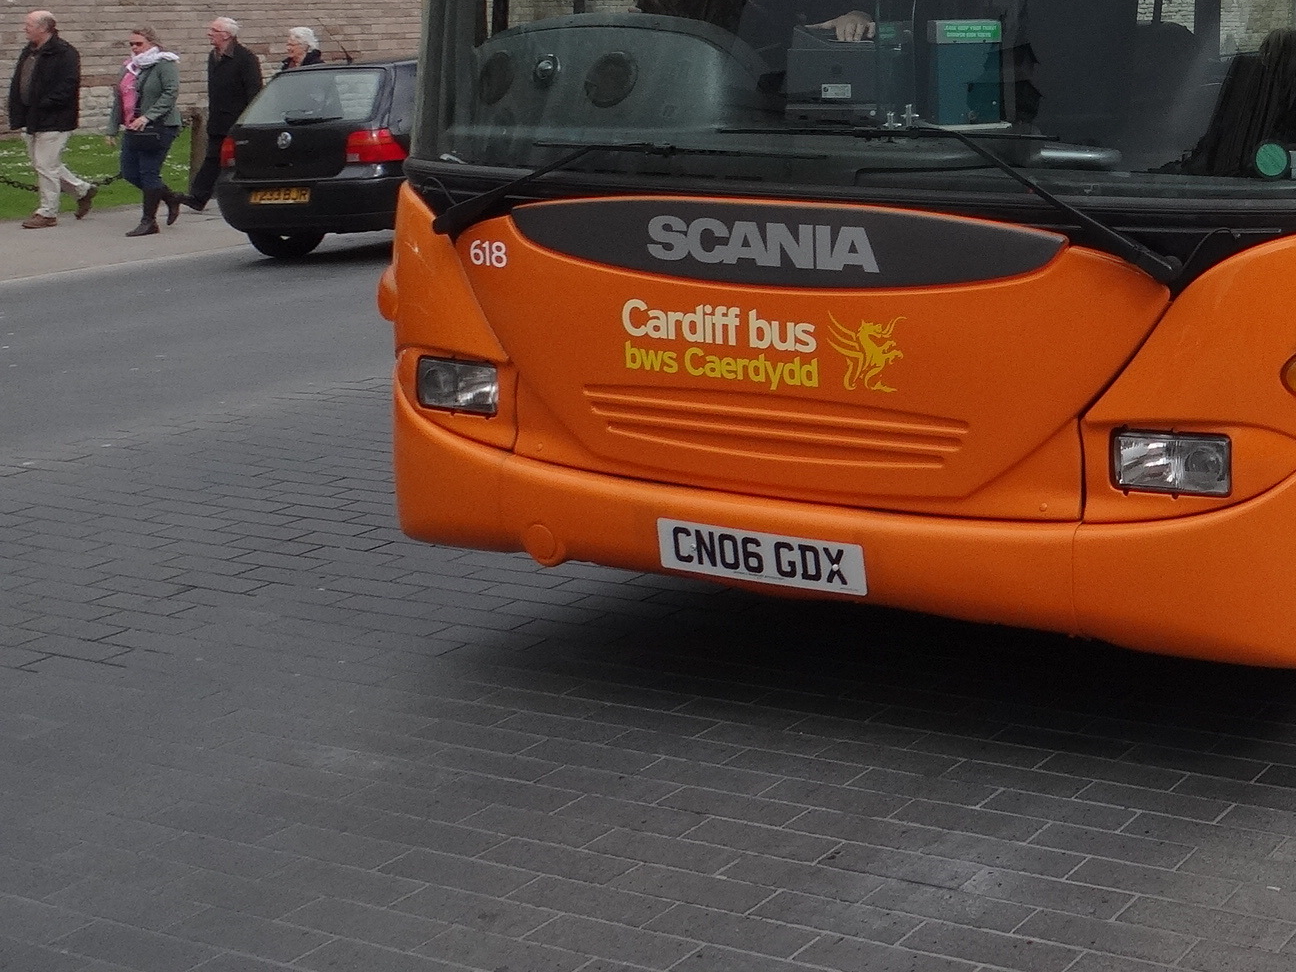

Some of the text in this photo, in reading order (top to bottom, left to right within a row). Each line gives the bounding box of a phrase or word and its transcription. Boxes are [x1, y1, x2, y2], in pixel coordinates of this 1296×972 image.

[469, 239, 508, 268] 618
[646, 215, 880, 273] SCANIA
[622, 298, 818, 353] Cardiff bus
[625, 340, 819, 391] bws Caerdydd
[672, 526, 850, 587] CN06 GDX
